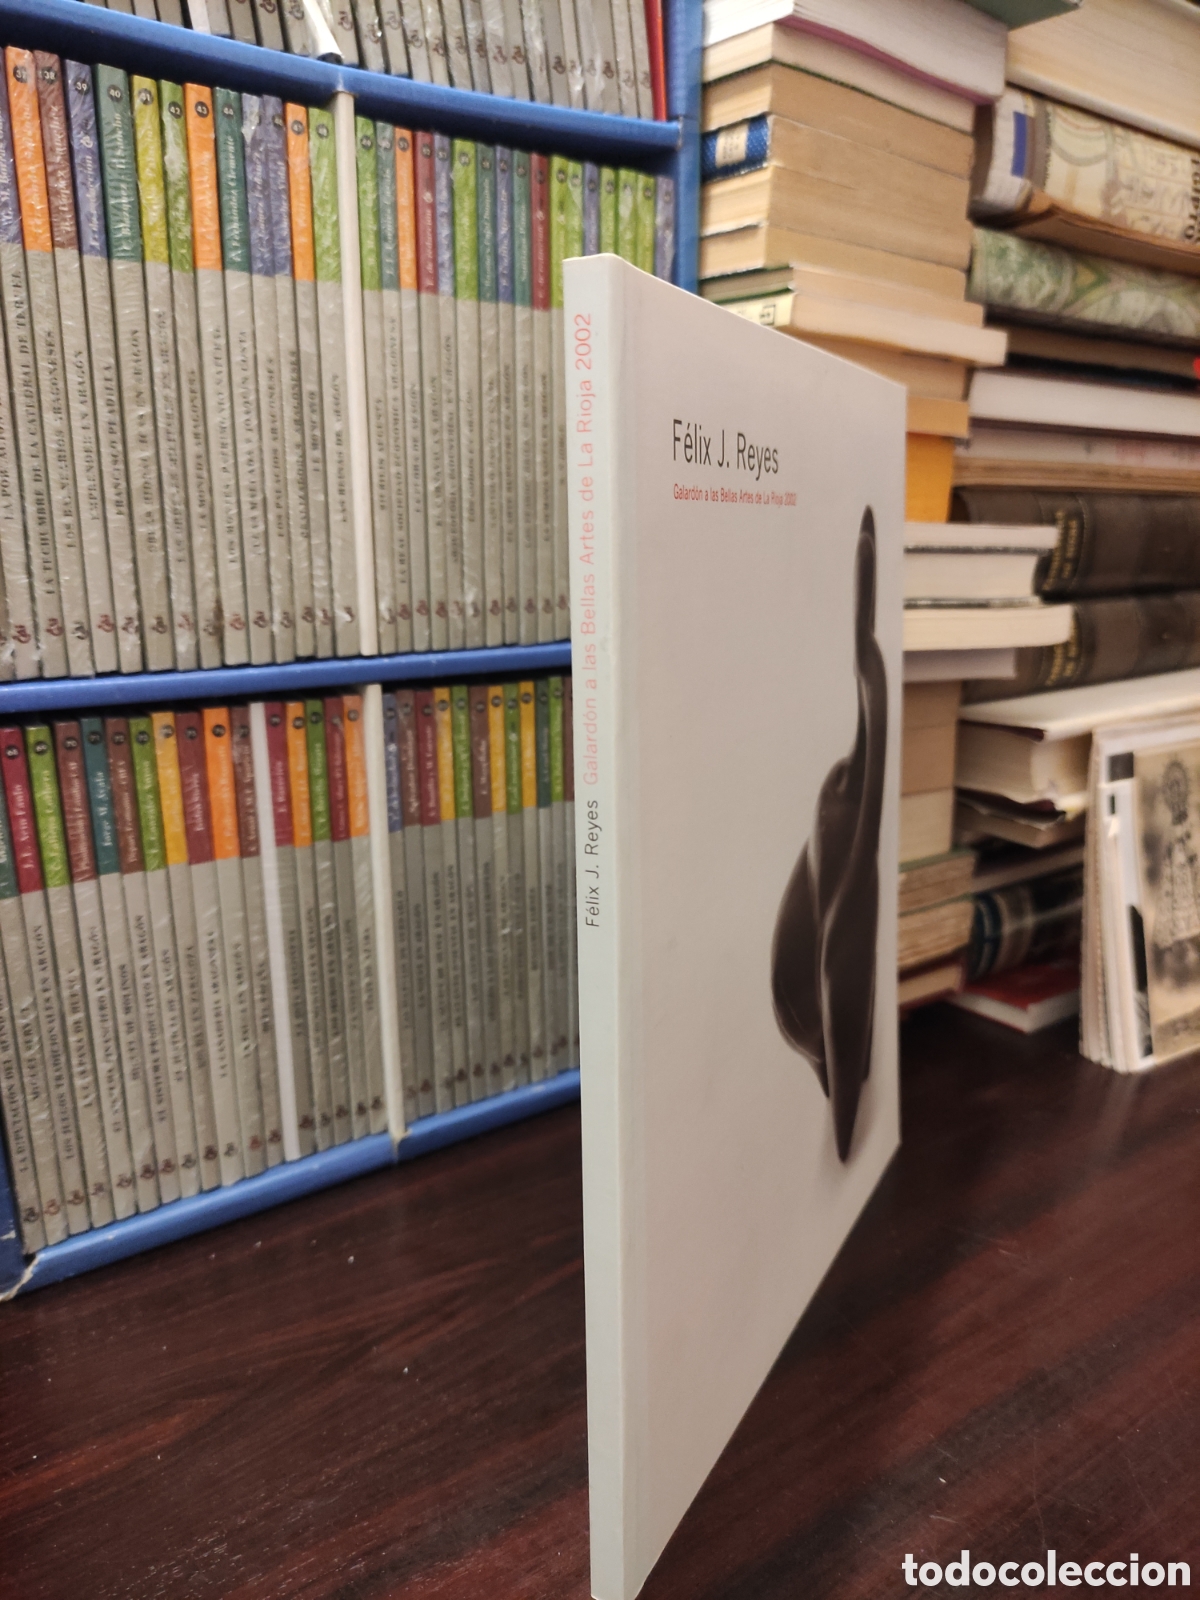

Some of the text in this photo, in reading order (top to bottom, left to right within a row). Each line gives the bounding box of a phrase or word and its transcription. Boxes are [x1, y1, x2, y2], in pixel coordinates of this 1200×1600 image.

[673, 418, 779, 481] Félix J. Reyes
[674, 483, 703, 500] Galardón
[704, 490, 708, 502] a
[710, 487, 718, 502] las
[720, 488, 738, 502] Bellas
[740, 489, 754, 504] Artes
[755, 491, 762, 504] de
[574, 314, 602, 928] Félix J. Reyes Galardón a las Bellas Artes de La Rioja 2002
